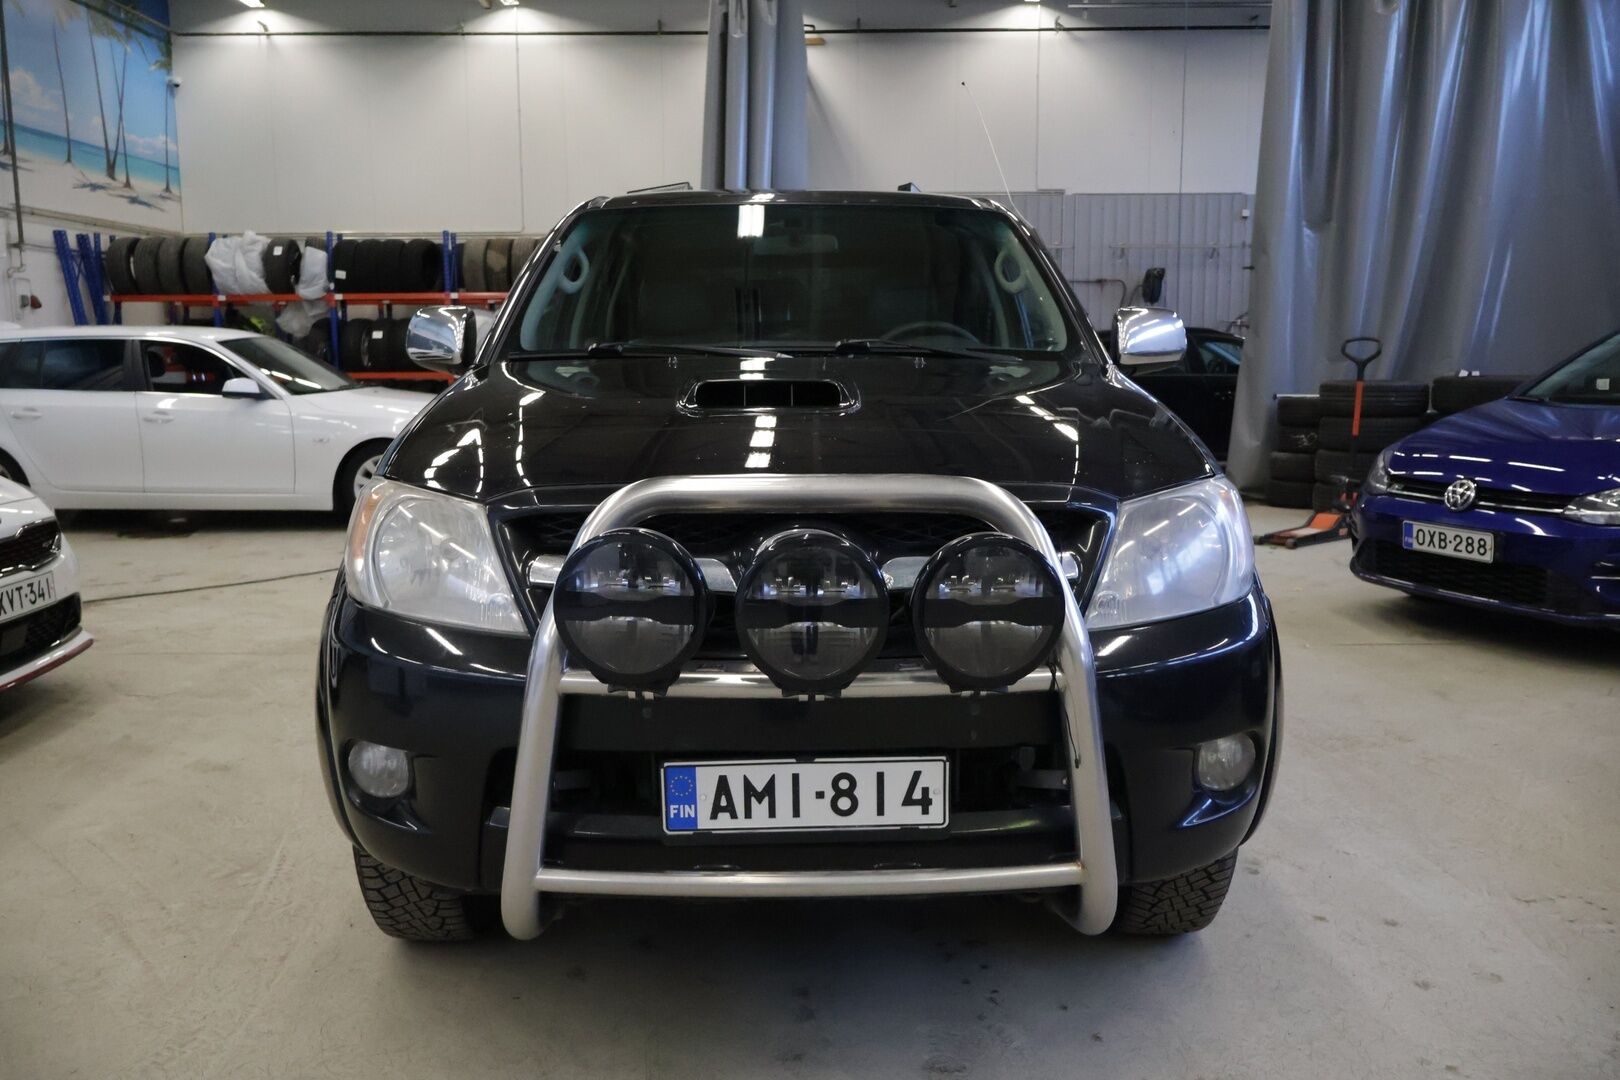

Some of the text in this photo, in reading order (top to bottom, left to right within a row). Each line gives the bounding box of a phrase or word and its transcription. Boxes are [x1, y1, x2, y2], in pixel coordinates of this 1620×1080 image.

[1416, 528, 1487, 556] OXB-288
[709, 770, 933, 821] AMI-814
[669, 804, 696, 819] FIN
